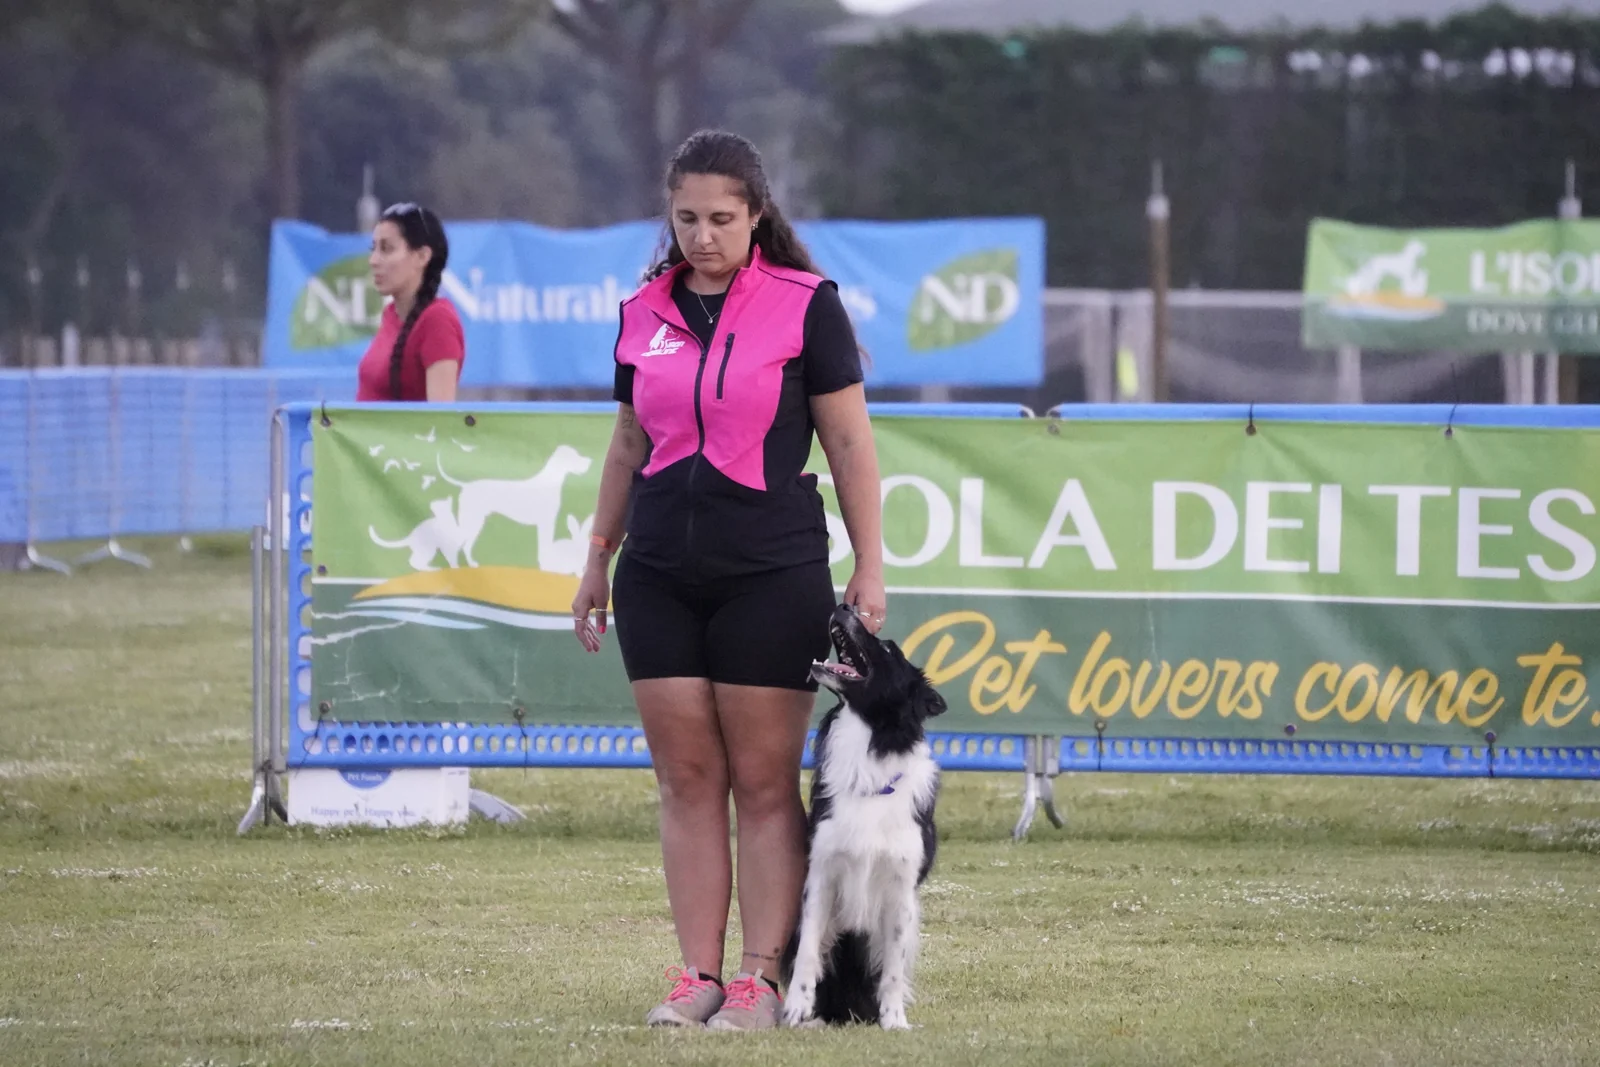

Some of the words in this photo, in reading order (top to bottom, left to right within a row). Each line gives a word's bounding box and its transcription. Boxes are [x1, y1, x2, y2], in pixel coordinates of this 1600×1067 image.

[1152, 480, 1342, 574] DEI
[1368, 485, 1597, 582] TES
[901, 610, 1067, 715] Pet
[1068, 629, 1280, 720] lovers
[1294, 661, 1505, 727] come
